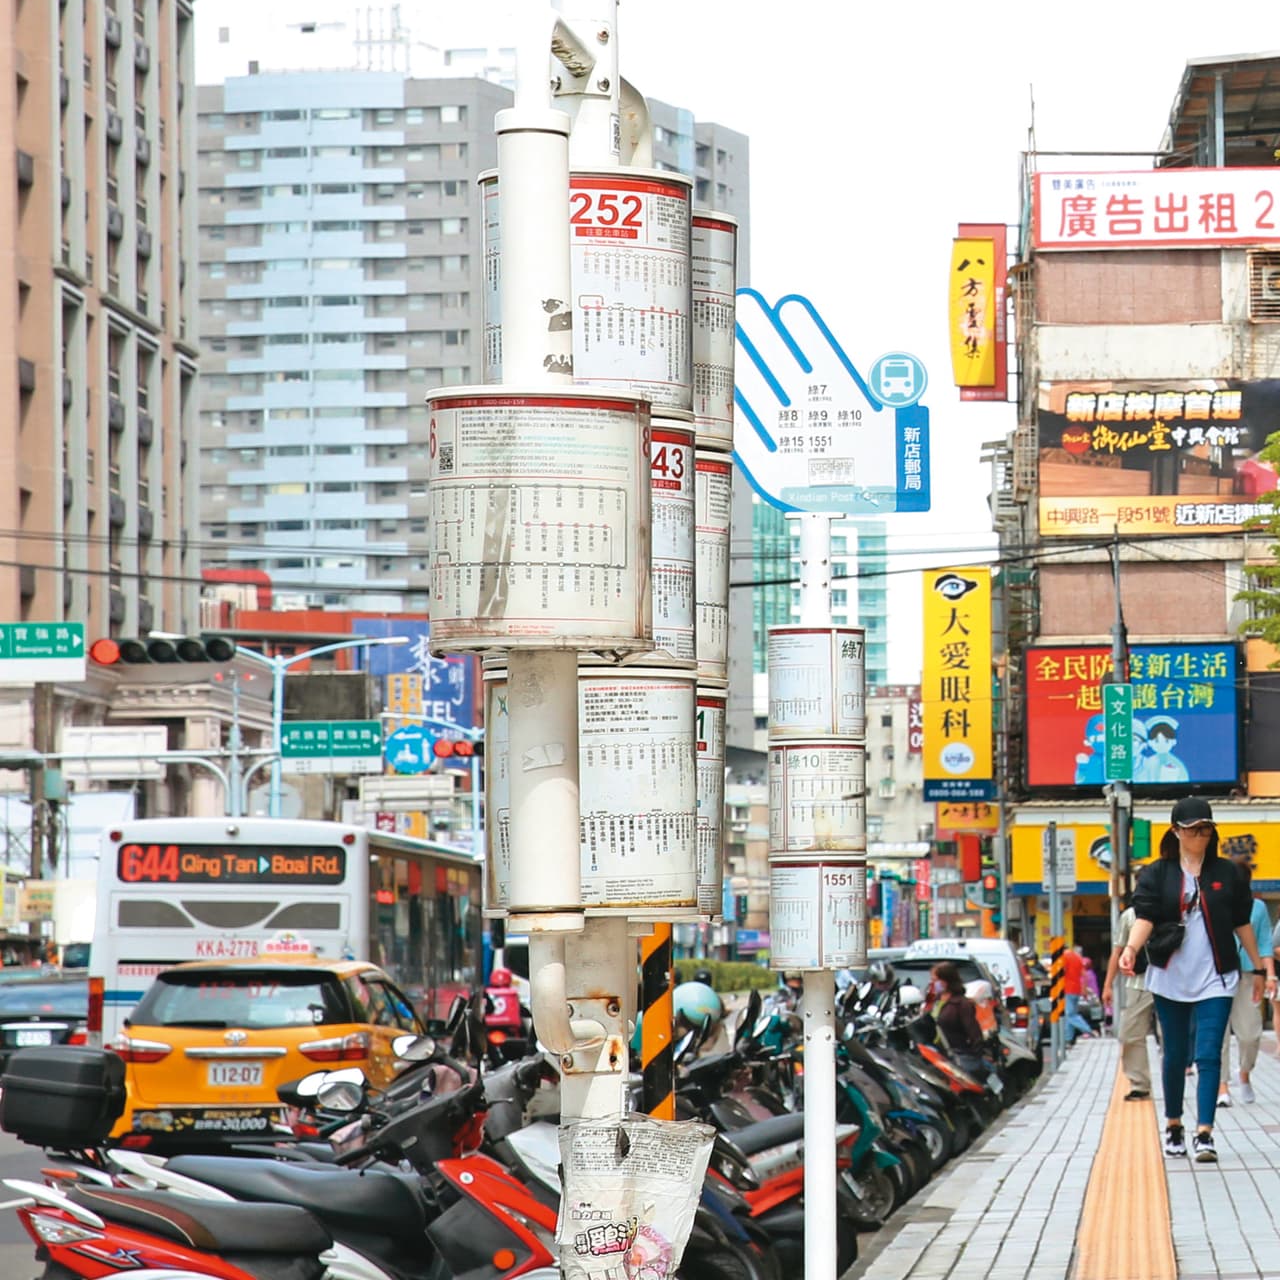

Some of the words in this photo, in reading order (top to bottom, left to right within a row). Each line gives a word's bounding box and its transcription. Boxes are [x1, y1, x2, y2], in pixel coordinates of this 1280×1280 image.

[570, 193, 643, 228] 252
[1059, 192, 1238, 237] 廣告出租
[809, 435, 832, 447] 1551
[651, 446, 684, 479] 43
[904, 427, 921, 490] 新店郵局
[1047, 506, 1171, 525] 中興路一段51號
[940, 607, 972, 739] 大愛眼科
[1048, 683, 1215, 711] 一起護台灣
[1110, 700, 1128, 760] 文化路
[122, 845, 179, 882] 644
[181, 854, 221, 877] Qing
[224, 854, 258, 874] Tan
[271, 855, 308, 874] Boai
[312, 855, 340, 874] Rd.
[823, 873, 854, 886] 1551
[212, 1066, 260, 1082] 112-07
